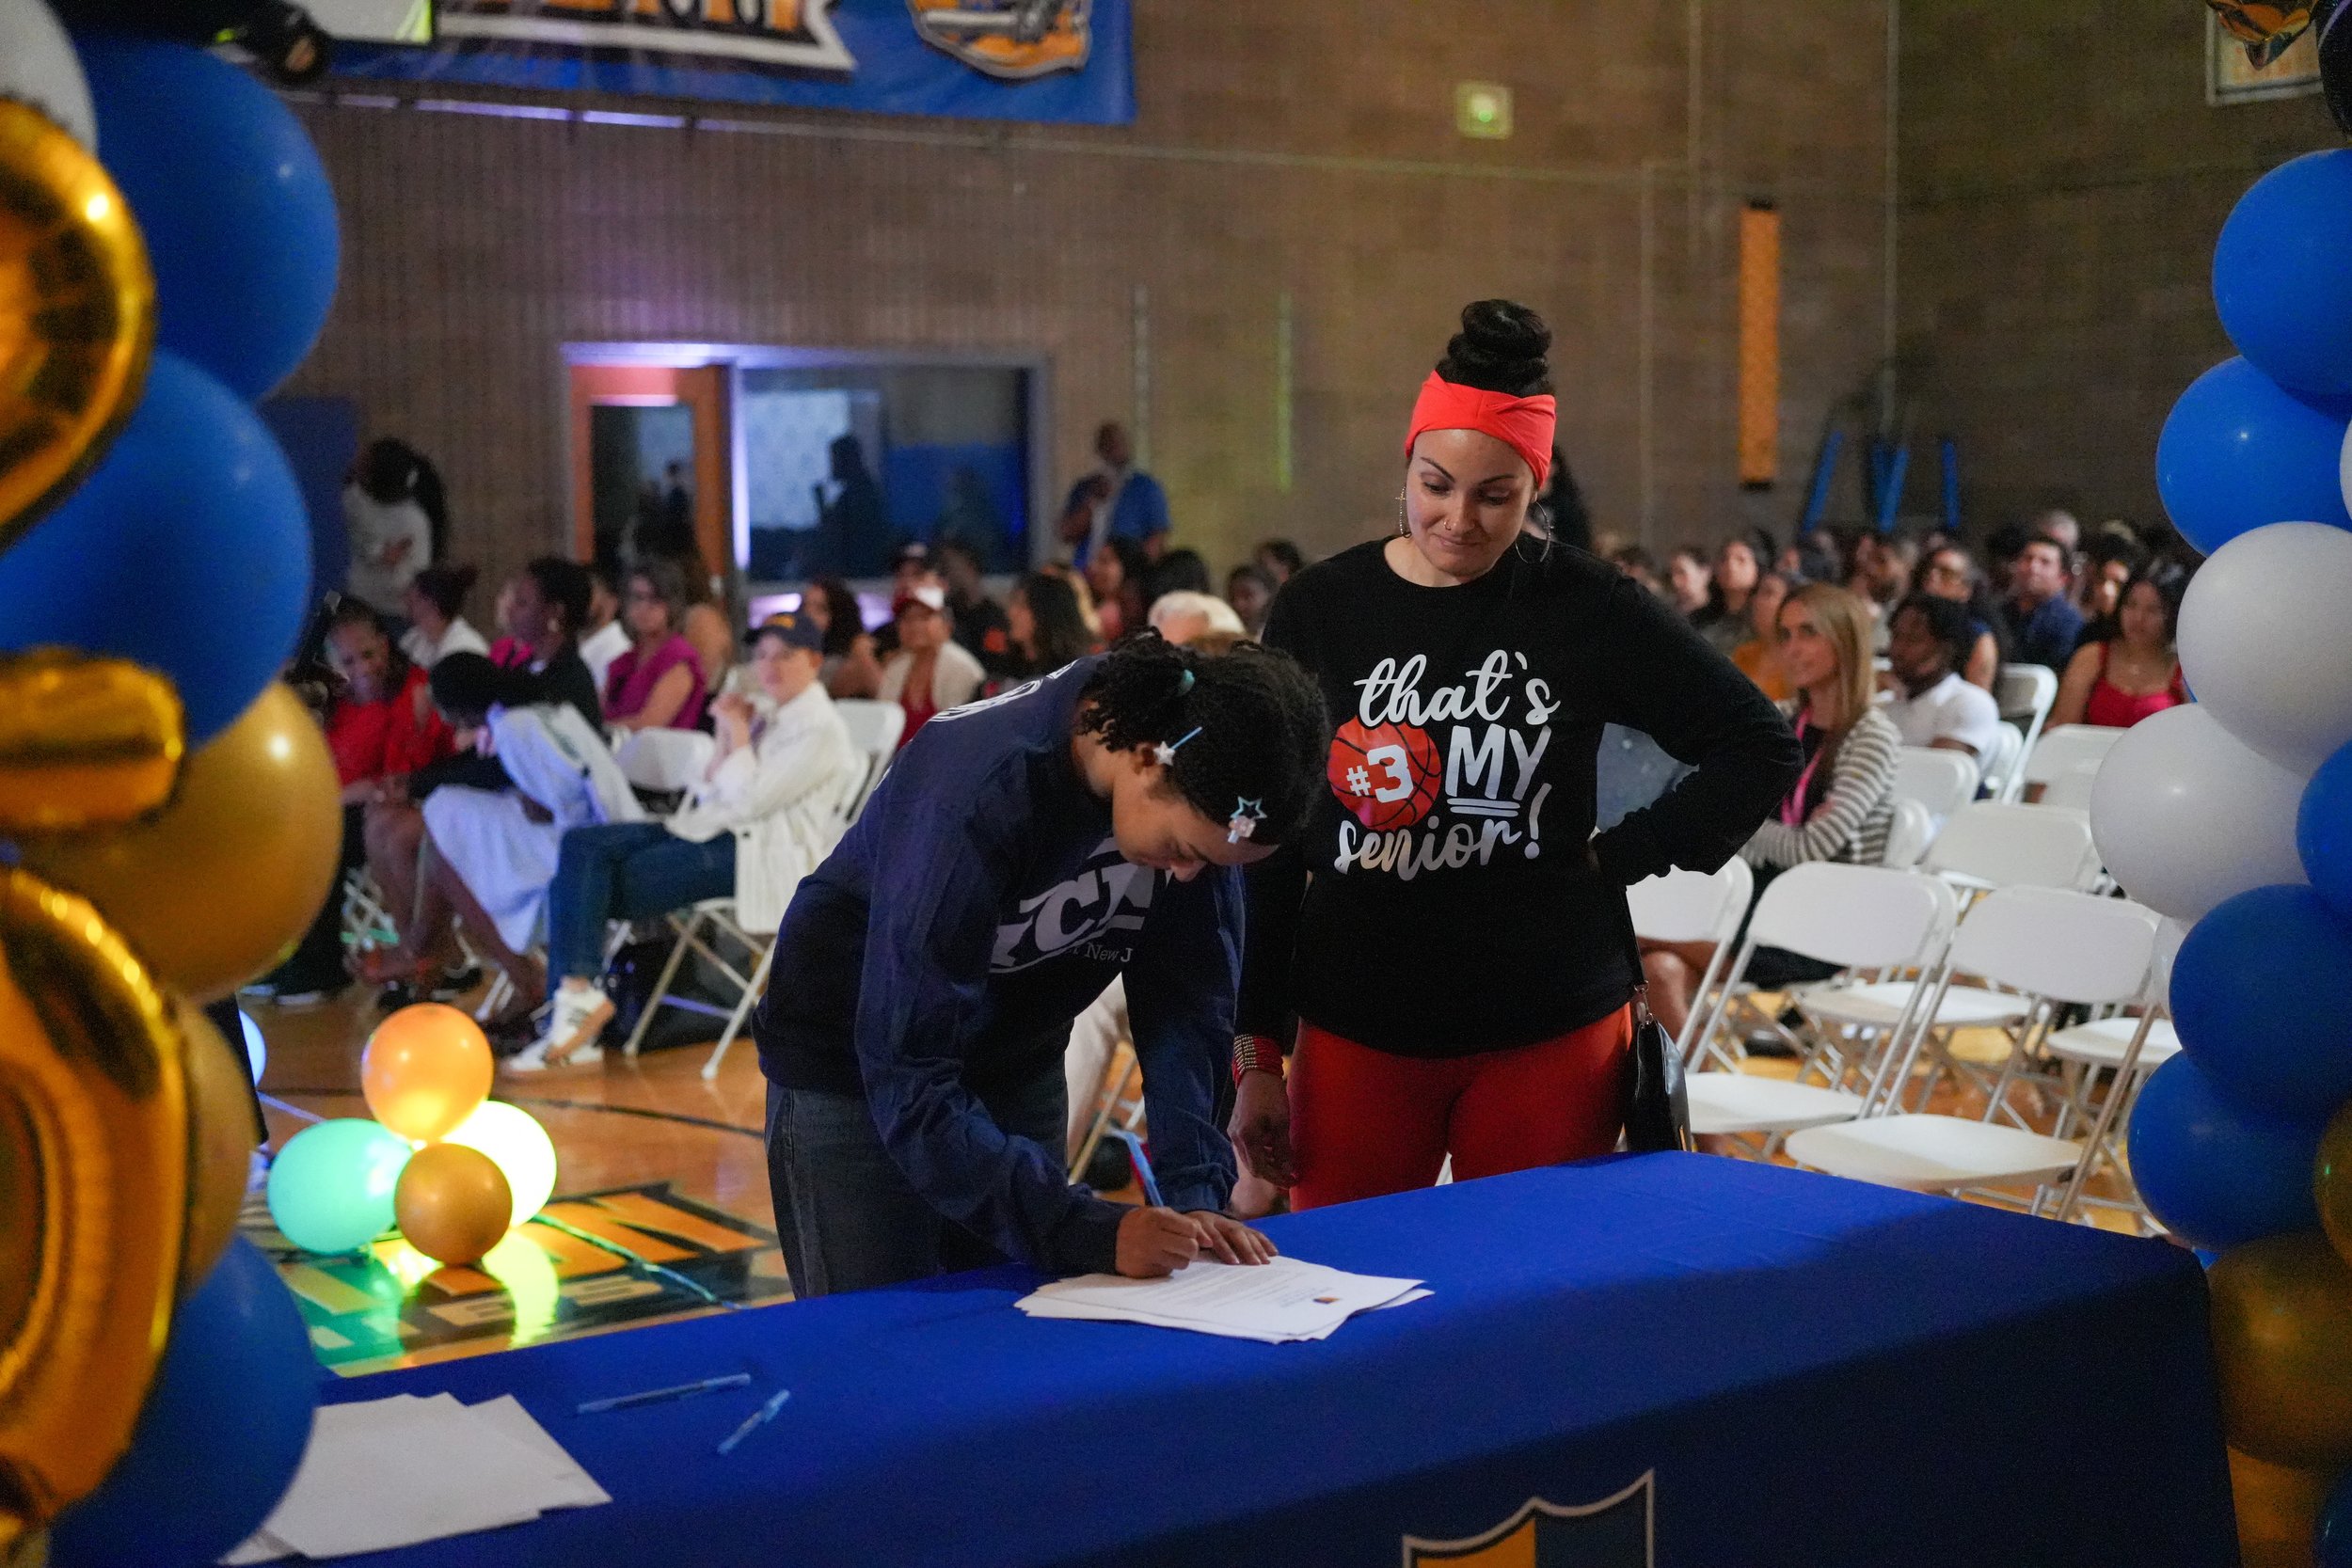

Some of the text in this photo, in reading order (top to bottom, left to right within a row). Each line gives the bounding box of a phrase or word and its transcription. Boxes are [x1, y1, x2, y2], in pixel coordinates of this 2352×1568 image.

[1346, 722, 1552, 803] #3 MY
[1333, 782, 1552, 881] senior!
[1084, 942, 1120, 960] New
